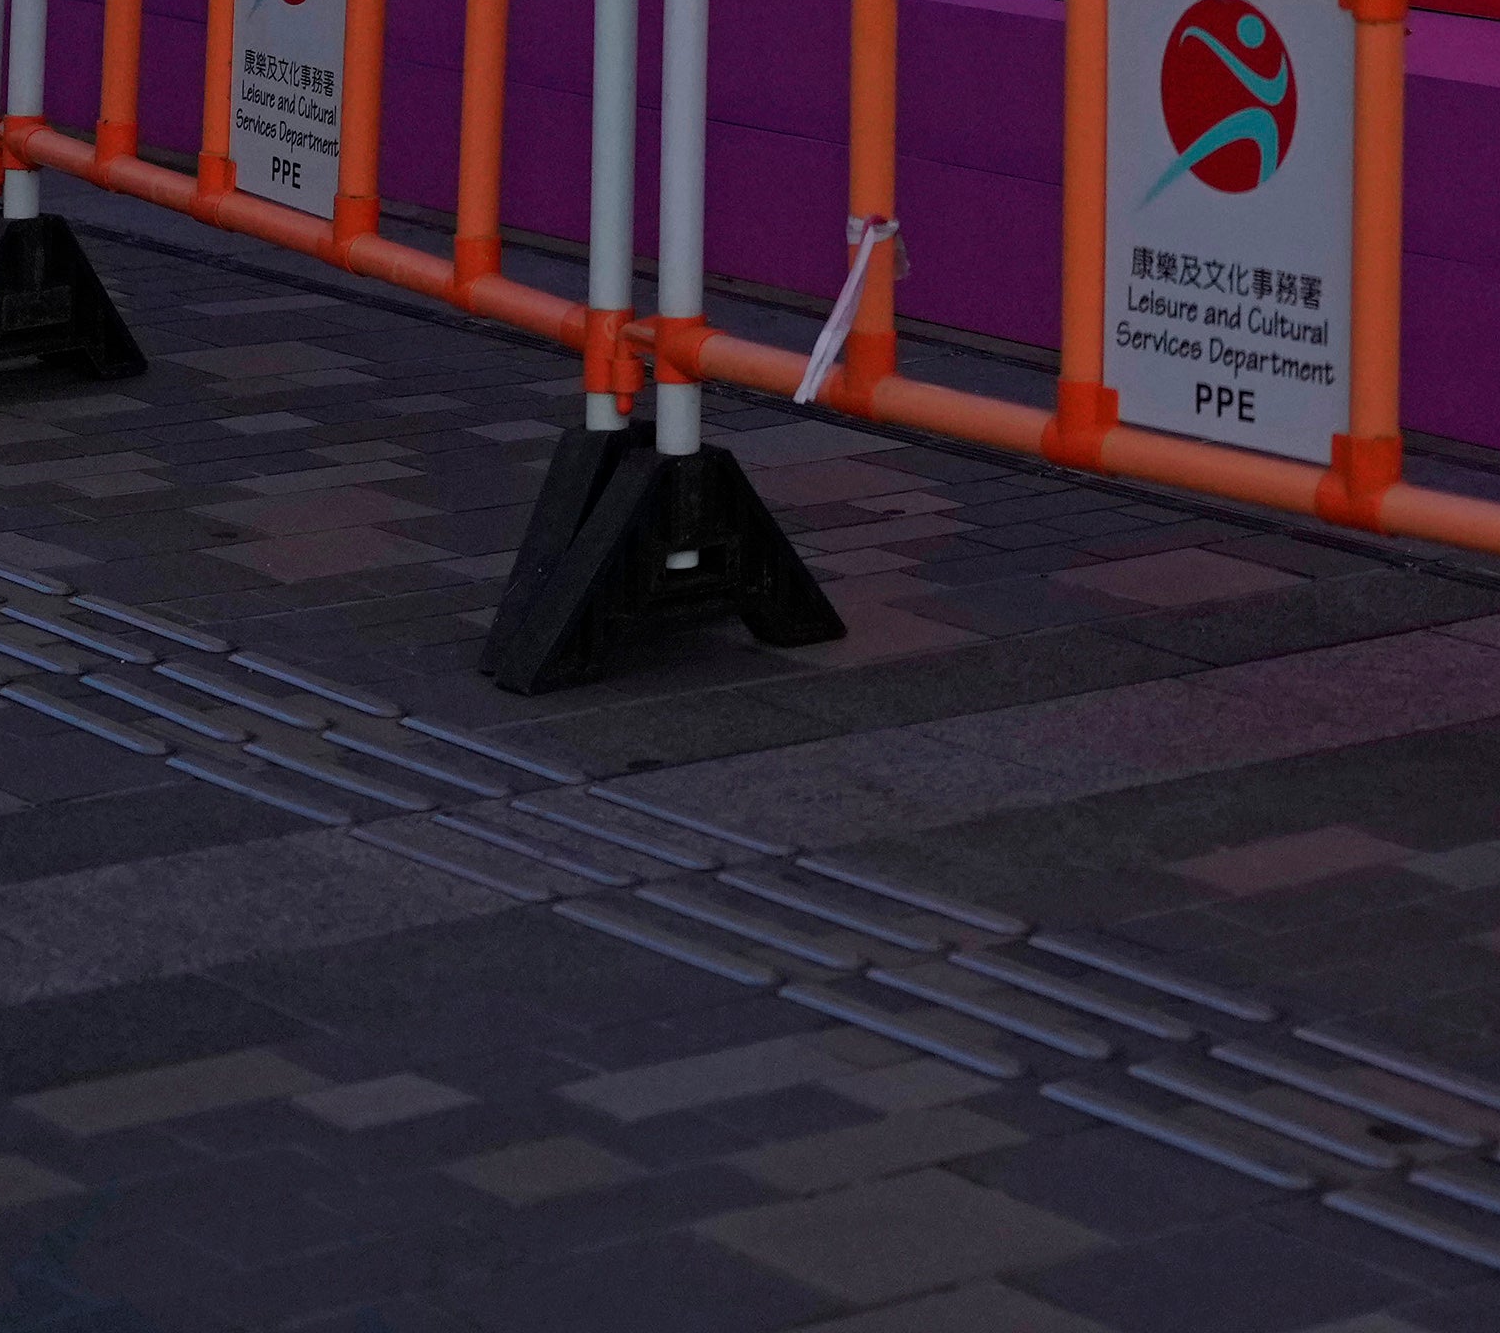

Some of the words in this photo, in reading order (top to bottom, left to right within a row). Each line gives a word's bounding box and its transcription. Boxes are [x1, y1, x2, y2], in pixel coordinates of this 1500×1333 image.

[244, 49, 335, 97] 康樂及文化事務署
[241, 80, 276, 108] Leisure
[277, 94, 296, 115] and
[298, 96, 337, 126] Cultural
[236, 108, 277, 139] Services
[279, 120, 340, 157] Department
[272, 156, 301, 189] PPE
[1131, 245, 1322, 310] 康樂及文化事務署
[1128, 285, 1198, 322] Leisure
[1204, 303, 1241, 330] and
[1248, 307, 1329, 346] Cultural
[1116, 320, 1202, 360] Services
[1210, 337, 1335, 385] Department
[1196, 383, 1255, 423] PPE
